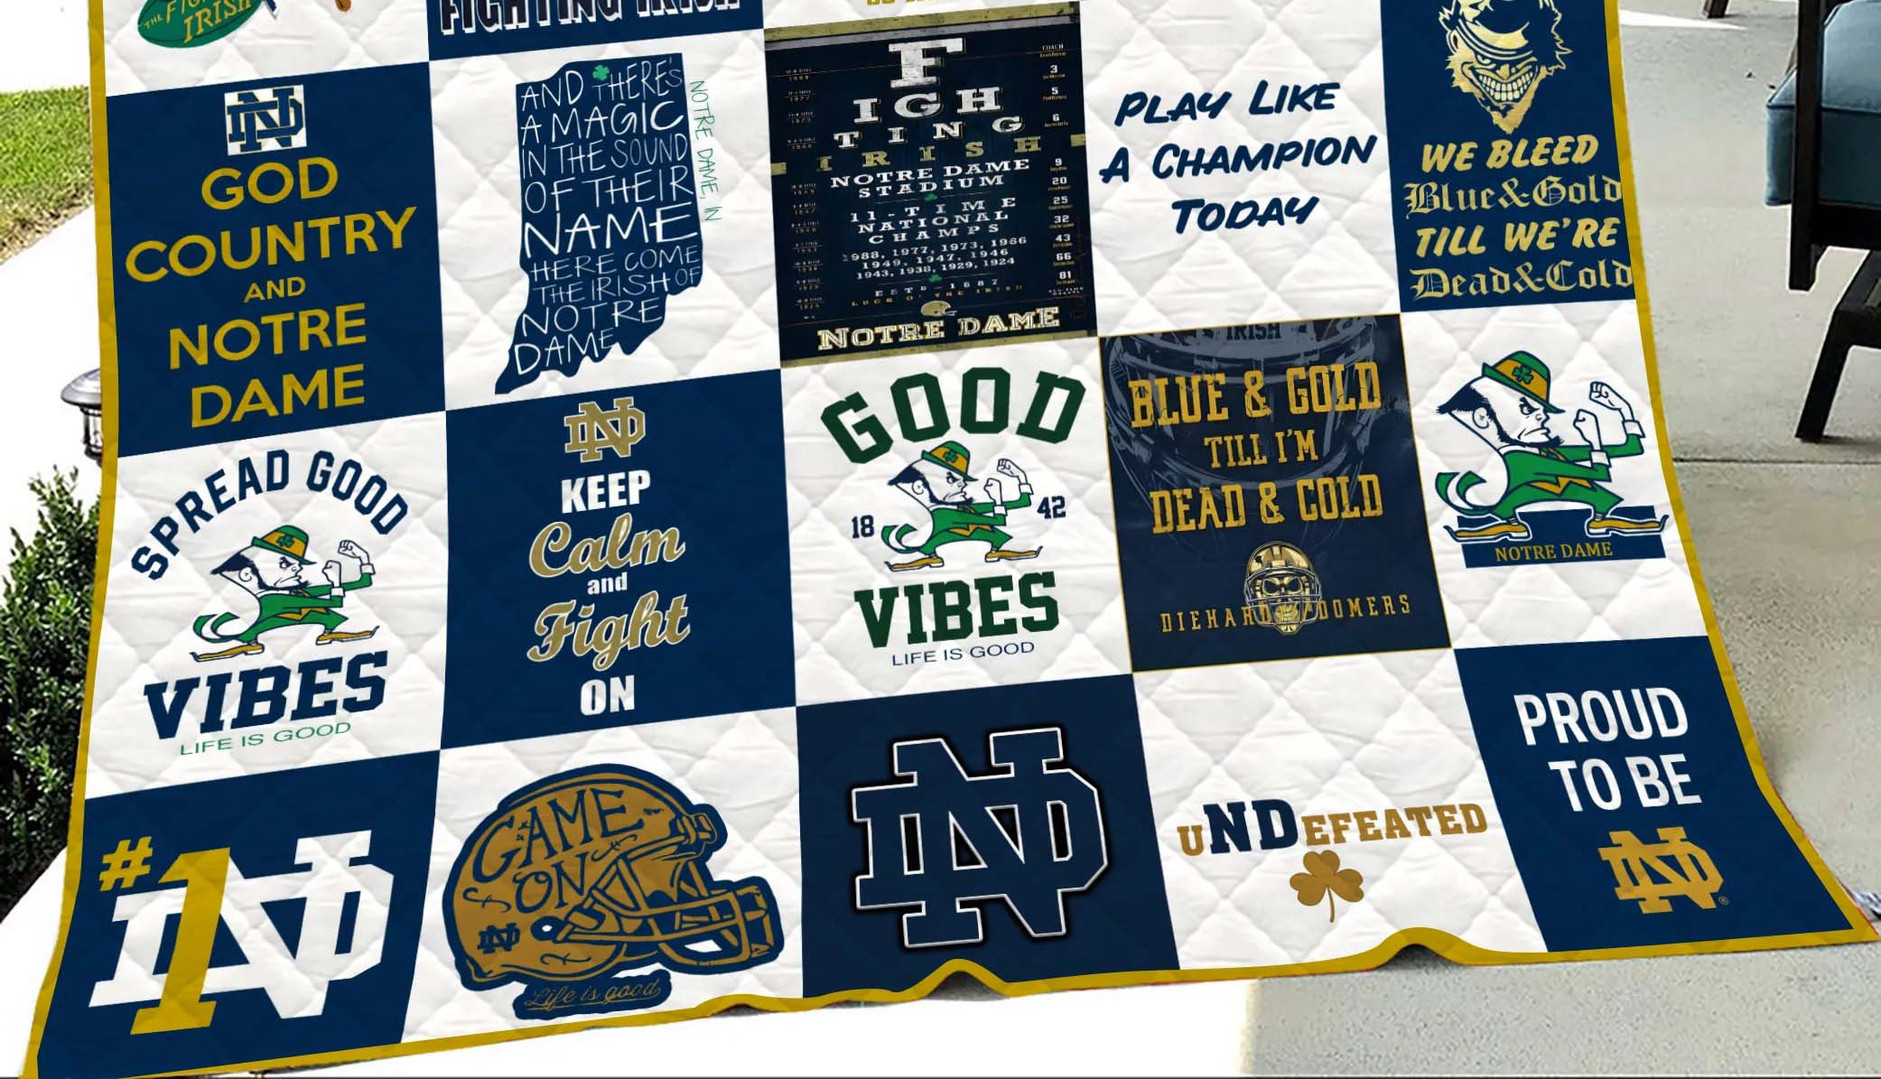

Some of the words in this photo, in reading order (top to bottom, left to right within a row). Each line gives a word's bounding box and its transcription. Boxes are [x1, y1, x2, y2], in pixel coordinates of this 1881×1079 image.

[144, 13, 163, 30] THE
[521, 114, 542, 145] A
[551, 101, 684, 142] MAGIC
[1114, 91, 1232, 127] PLAY
[1248, 79, 1341, 115] LIKE
[831, 167, 933, 188] NOTRE
[944, 159, 1030, 177] DAME
[1099, 147, 1129, 184] A
[1152, 134, 1378, 180] CHAMPION
[1422, 141, 1477, 173] WE
[1486, 134, 1599, 169] BLEED
[201, 156, 340, 211] GOD
[859, 174, 1004, 198] STADIUM
[1052, 177, 1067, 185] 20
[1053, 196, 1068, 204] 25
[1403, 174, 1623, 220] Blue&Gold
[524, 201, 698, 258] NAME
[858, 210, 1008, 234] NATIONAL
[869, 224, 999, 244] CHAMPS
[1054, 215, 1070, 224] 32
[1171, 195, 1320, 235] TODAY
[125, 206, 417, 283] COUNTRY
[970, 248, 1009, 259] 1946
[1056, 252, 1072, 261] 66
[1416, 224, 1486, 257] TILL
[1504, 217, 1621, 252] WE'RE
[983, 257, 1015, 267] 1924
[1409, 259, 1633, 302] Dead&Cold
[243, 276, 306, 303] AND
[169, 302, 367, 370] NOTRE
[521, 297, 663, 337] NOTRE
[817, 320, 945, 351] NOTRE
[957, 306, 1060, 336] DAME
[514, 329, 616, 375] DAME
[191, 363, 365, 429] DAME
[820, 366, 1086, 464] GOOD
[1127, 373, 1229, 428] BLUE
[1243, 370, 1272, 418] &
[1286, 361, 1382, 415] GOLD
[1204, 432, 1267, 469] TILL
[1275, 428, 1319, 464] I'M
[561, 469, 651, 514] KEEP
[1036, 495, 1066, 520] 42
[1149, 483, 1246, 534] DEAD
[1258, 481, 1285, 525] &
[1296, 473, 1384, 522] COLD
[131, 449, 289, 581] SPREAD
[306, 449, 409, 535] GOOD
[851, 515, 875, 539] 18
[528, 512, 686, 578] Calm
[1495, 542, 1556, 562] NOTRE
[1560, 541, 1613, 558] DAME
[587, 572, 628, 595] and
[526, 590, 691, 672] Fight
[854, 570, 1060, 649] VIBES
[1160, 604, 1272, 633] DIEHARD
[1317, 594, 1411, 620] DOMERS
[892, 648, 937, 666] LIFE
[944, 648, 963, 661] IS
[969, 641, 1035, 658] GOOD
[143, 650, 388, 740] VIBES
[580, 675, 635, 716] ON
[1513, 687, 1689, 746] PROUD
[1548, 758, 1622, 812] TO
[1624, 753, 1702, 808] BE
[471, 787, 644, 884] GAME
[512, 852, 594, 914] ON
